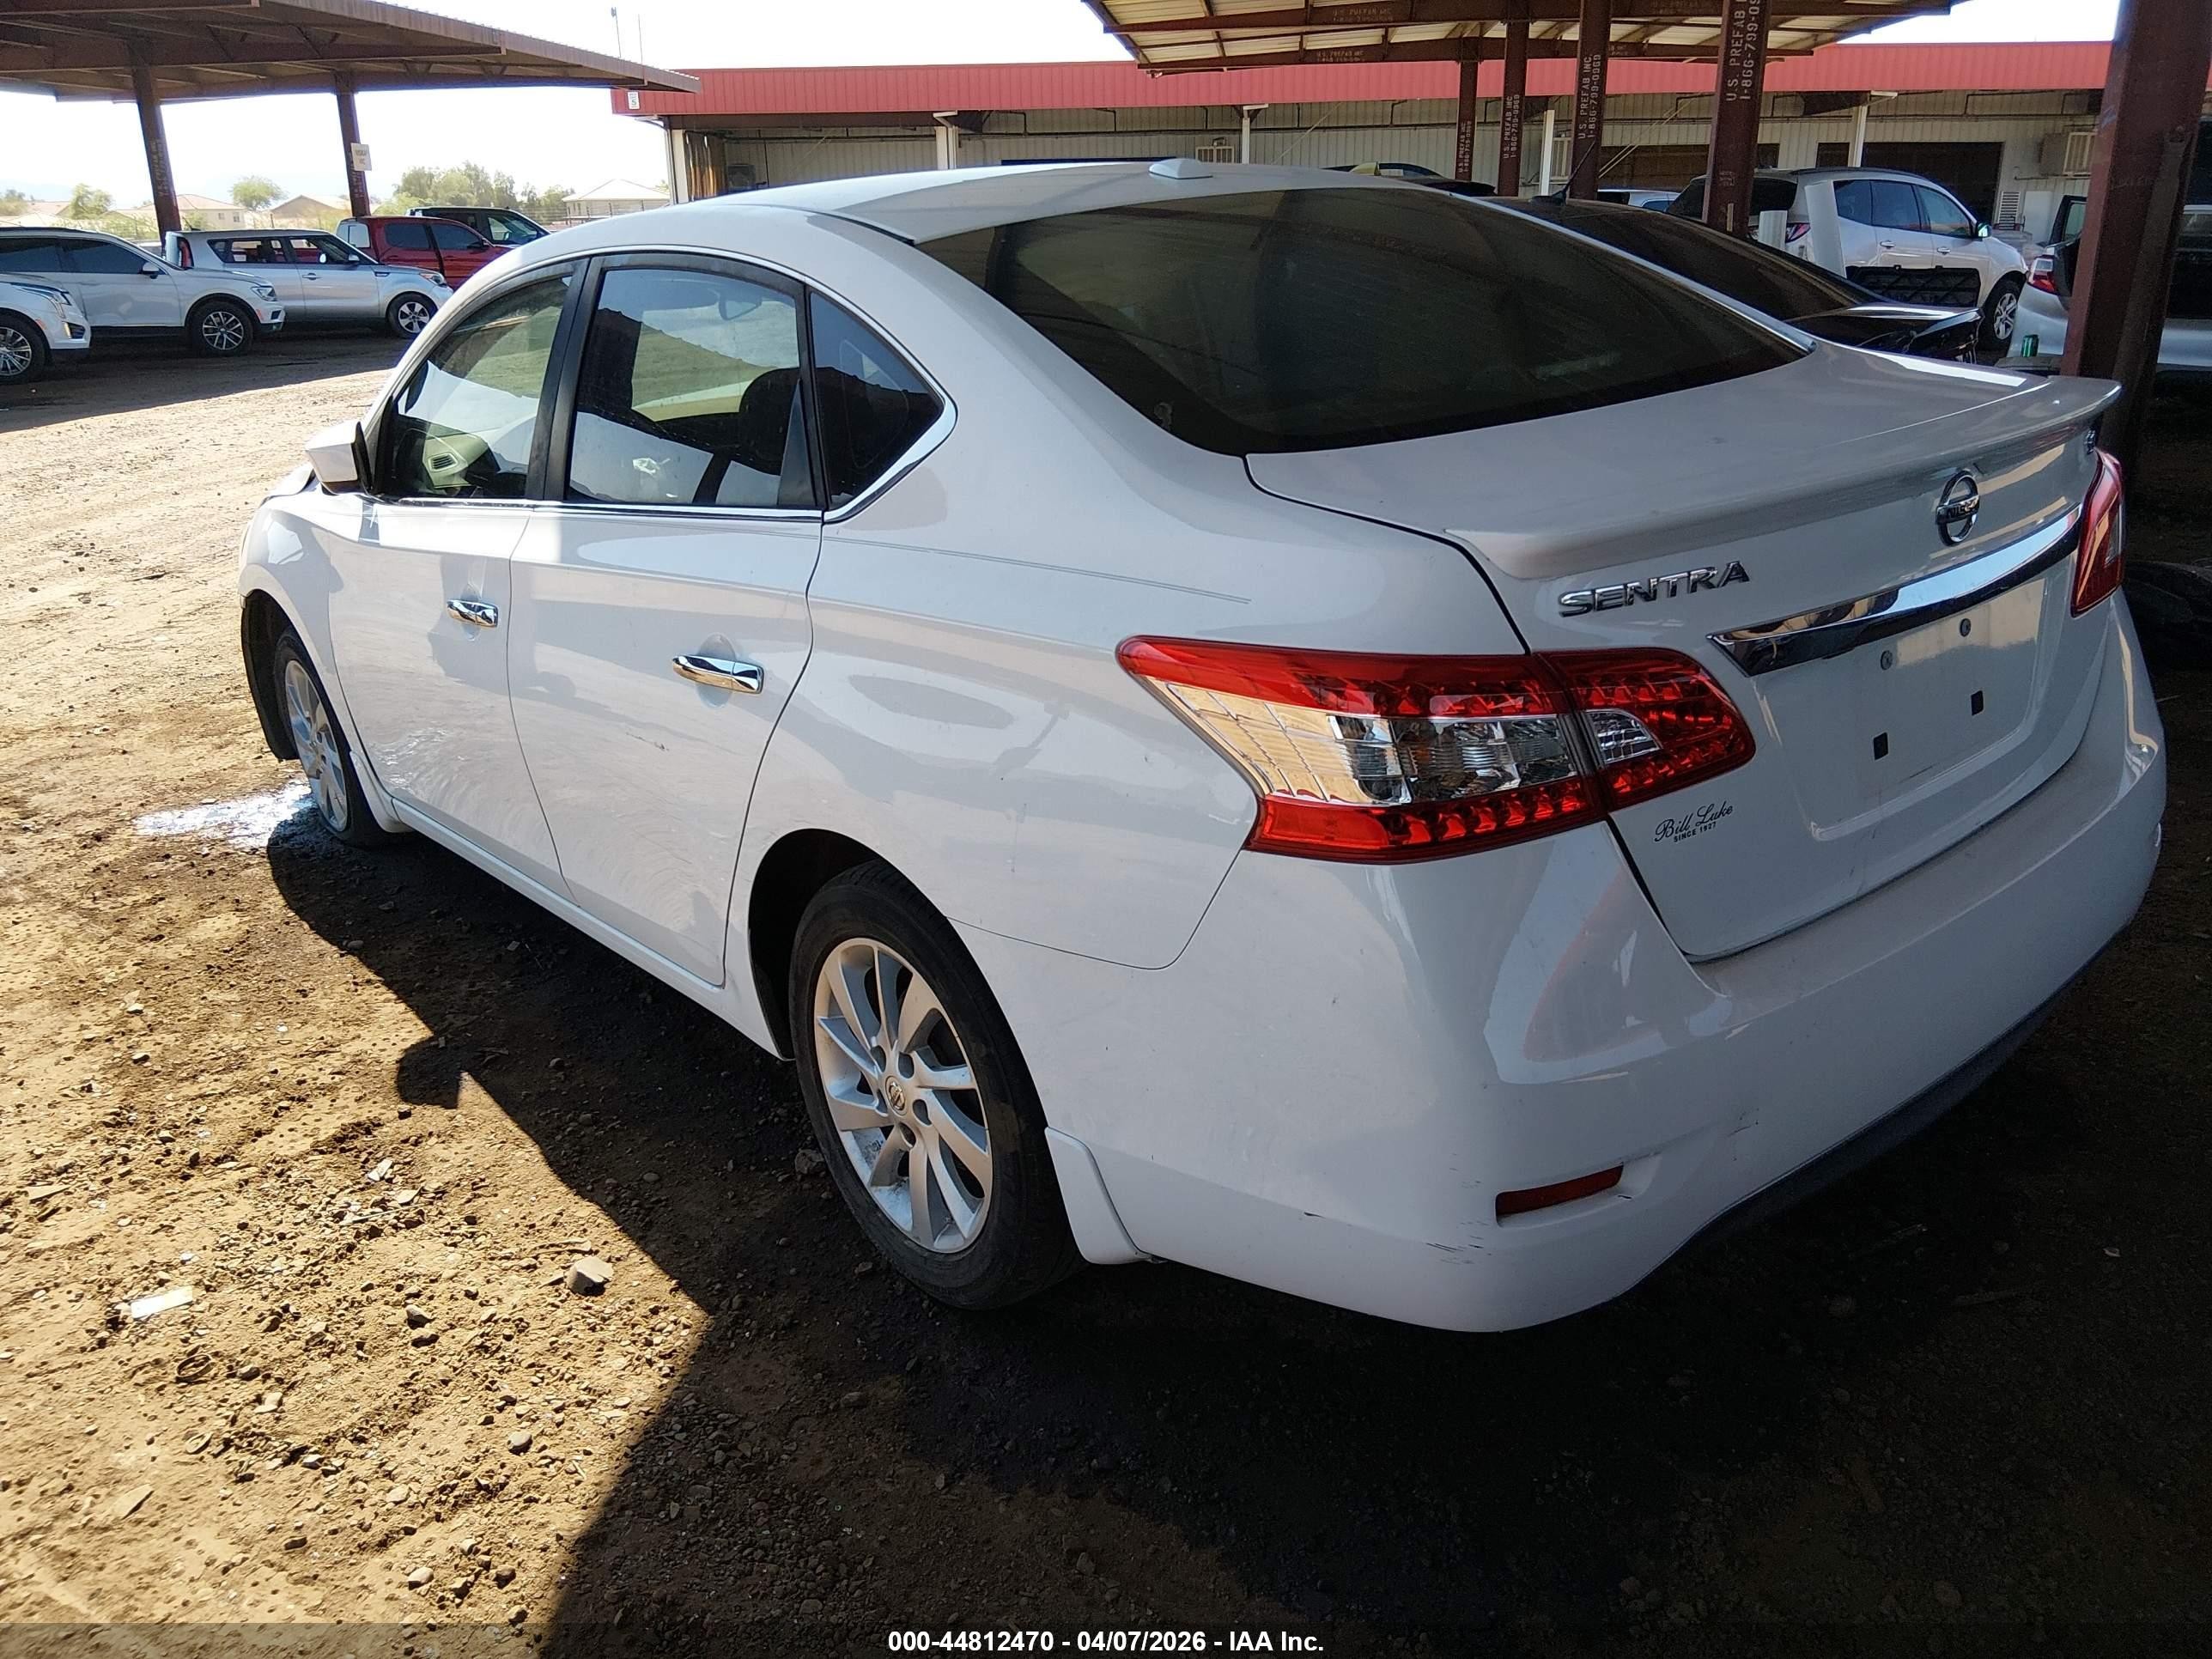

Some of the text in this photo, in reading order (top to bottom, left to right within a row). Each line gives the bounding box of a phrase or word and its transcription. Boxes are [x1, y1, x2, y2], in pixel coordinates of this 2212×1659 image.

[1729, 10, 1746, 66] PREFAB
[1580, 77, 1590, 115] PREFAB
[1726, 73, 1740, 101] U.S.
[1504, 112, 1512, 140] PREFAB
[1559, 560, 1750, 617] SENTRA
[1654, 801, 1733, 842] Bill Luke
[1674, 821, 1717, 842] SINCE 1927
